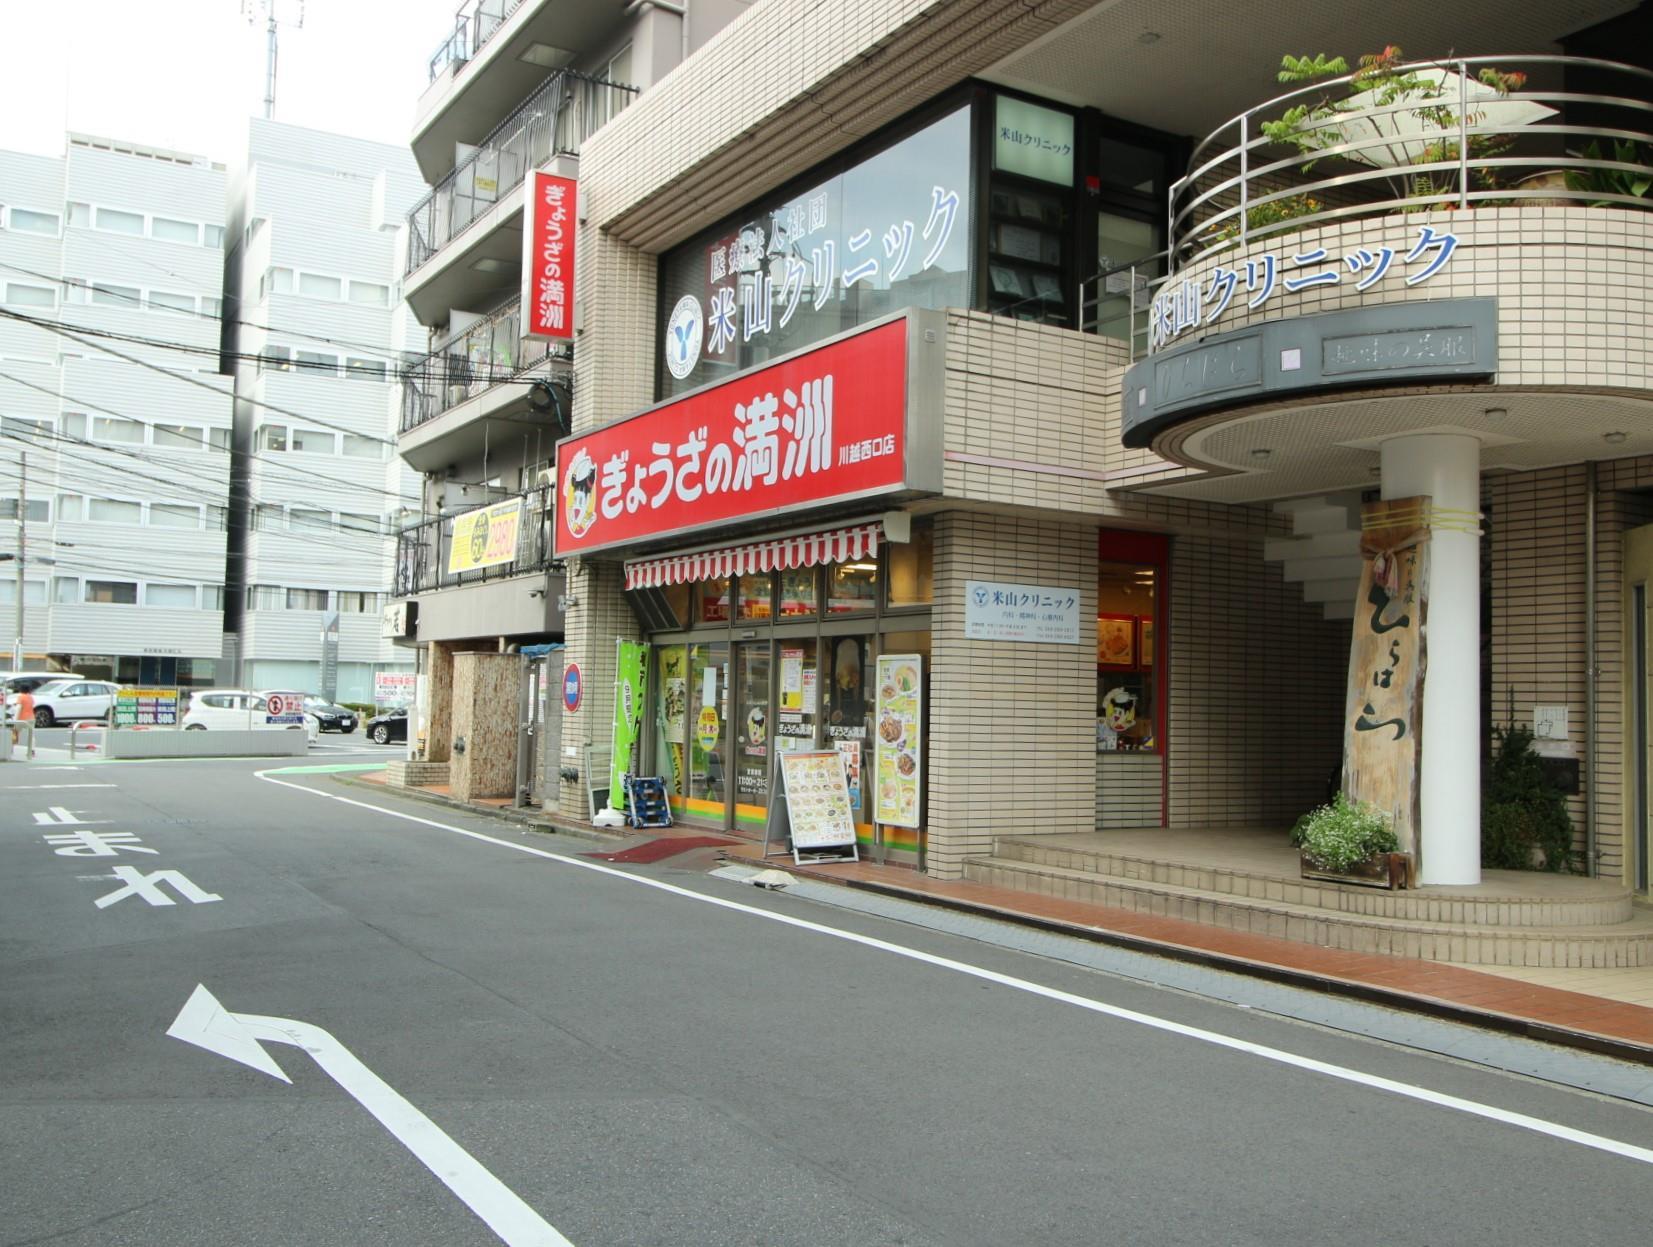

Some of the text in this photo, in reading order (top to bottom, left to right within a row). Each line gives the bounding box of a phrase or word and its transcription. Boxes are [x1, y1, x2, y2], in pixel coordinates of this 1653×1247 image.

[1000, 126, 1072, 156] 米山クリニック
[539, 183, 567, 330] ぎょうざの満洲
[707, 185, 960, 354] 米山クリニック
[710, 192, 828, 285] 医療法人社団
[1150, 226, 1459, 347] 米山クリニック
[600, 374, 834, 520] ぎょうざの満洲
[838, 433, 896, 467] 川越西口店
[992, 589, 1075, 610] 米山クリニック
